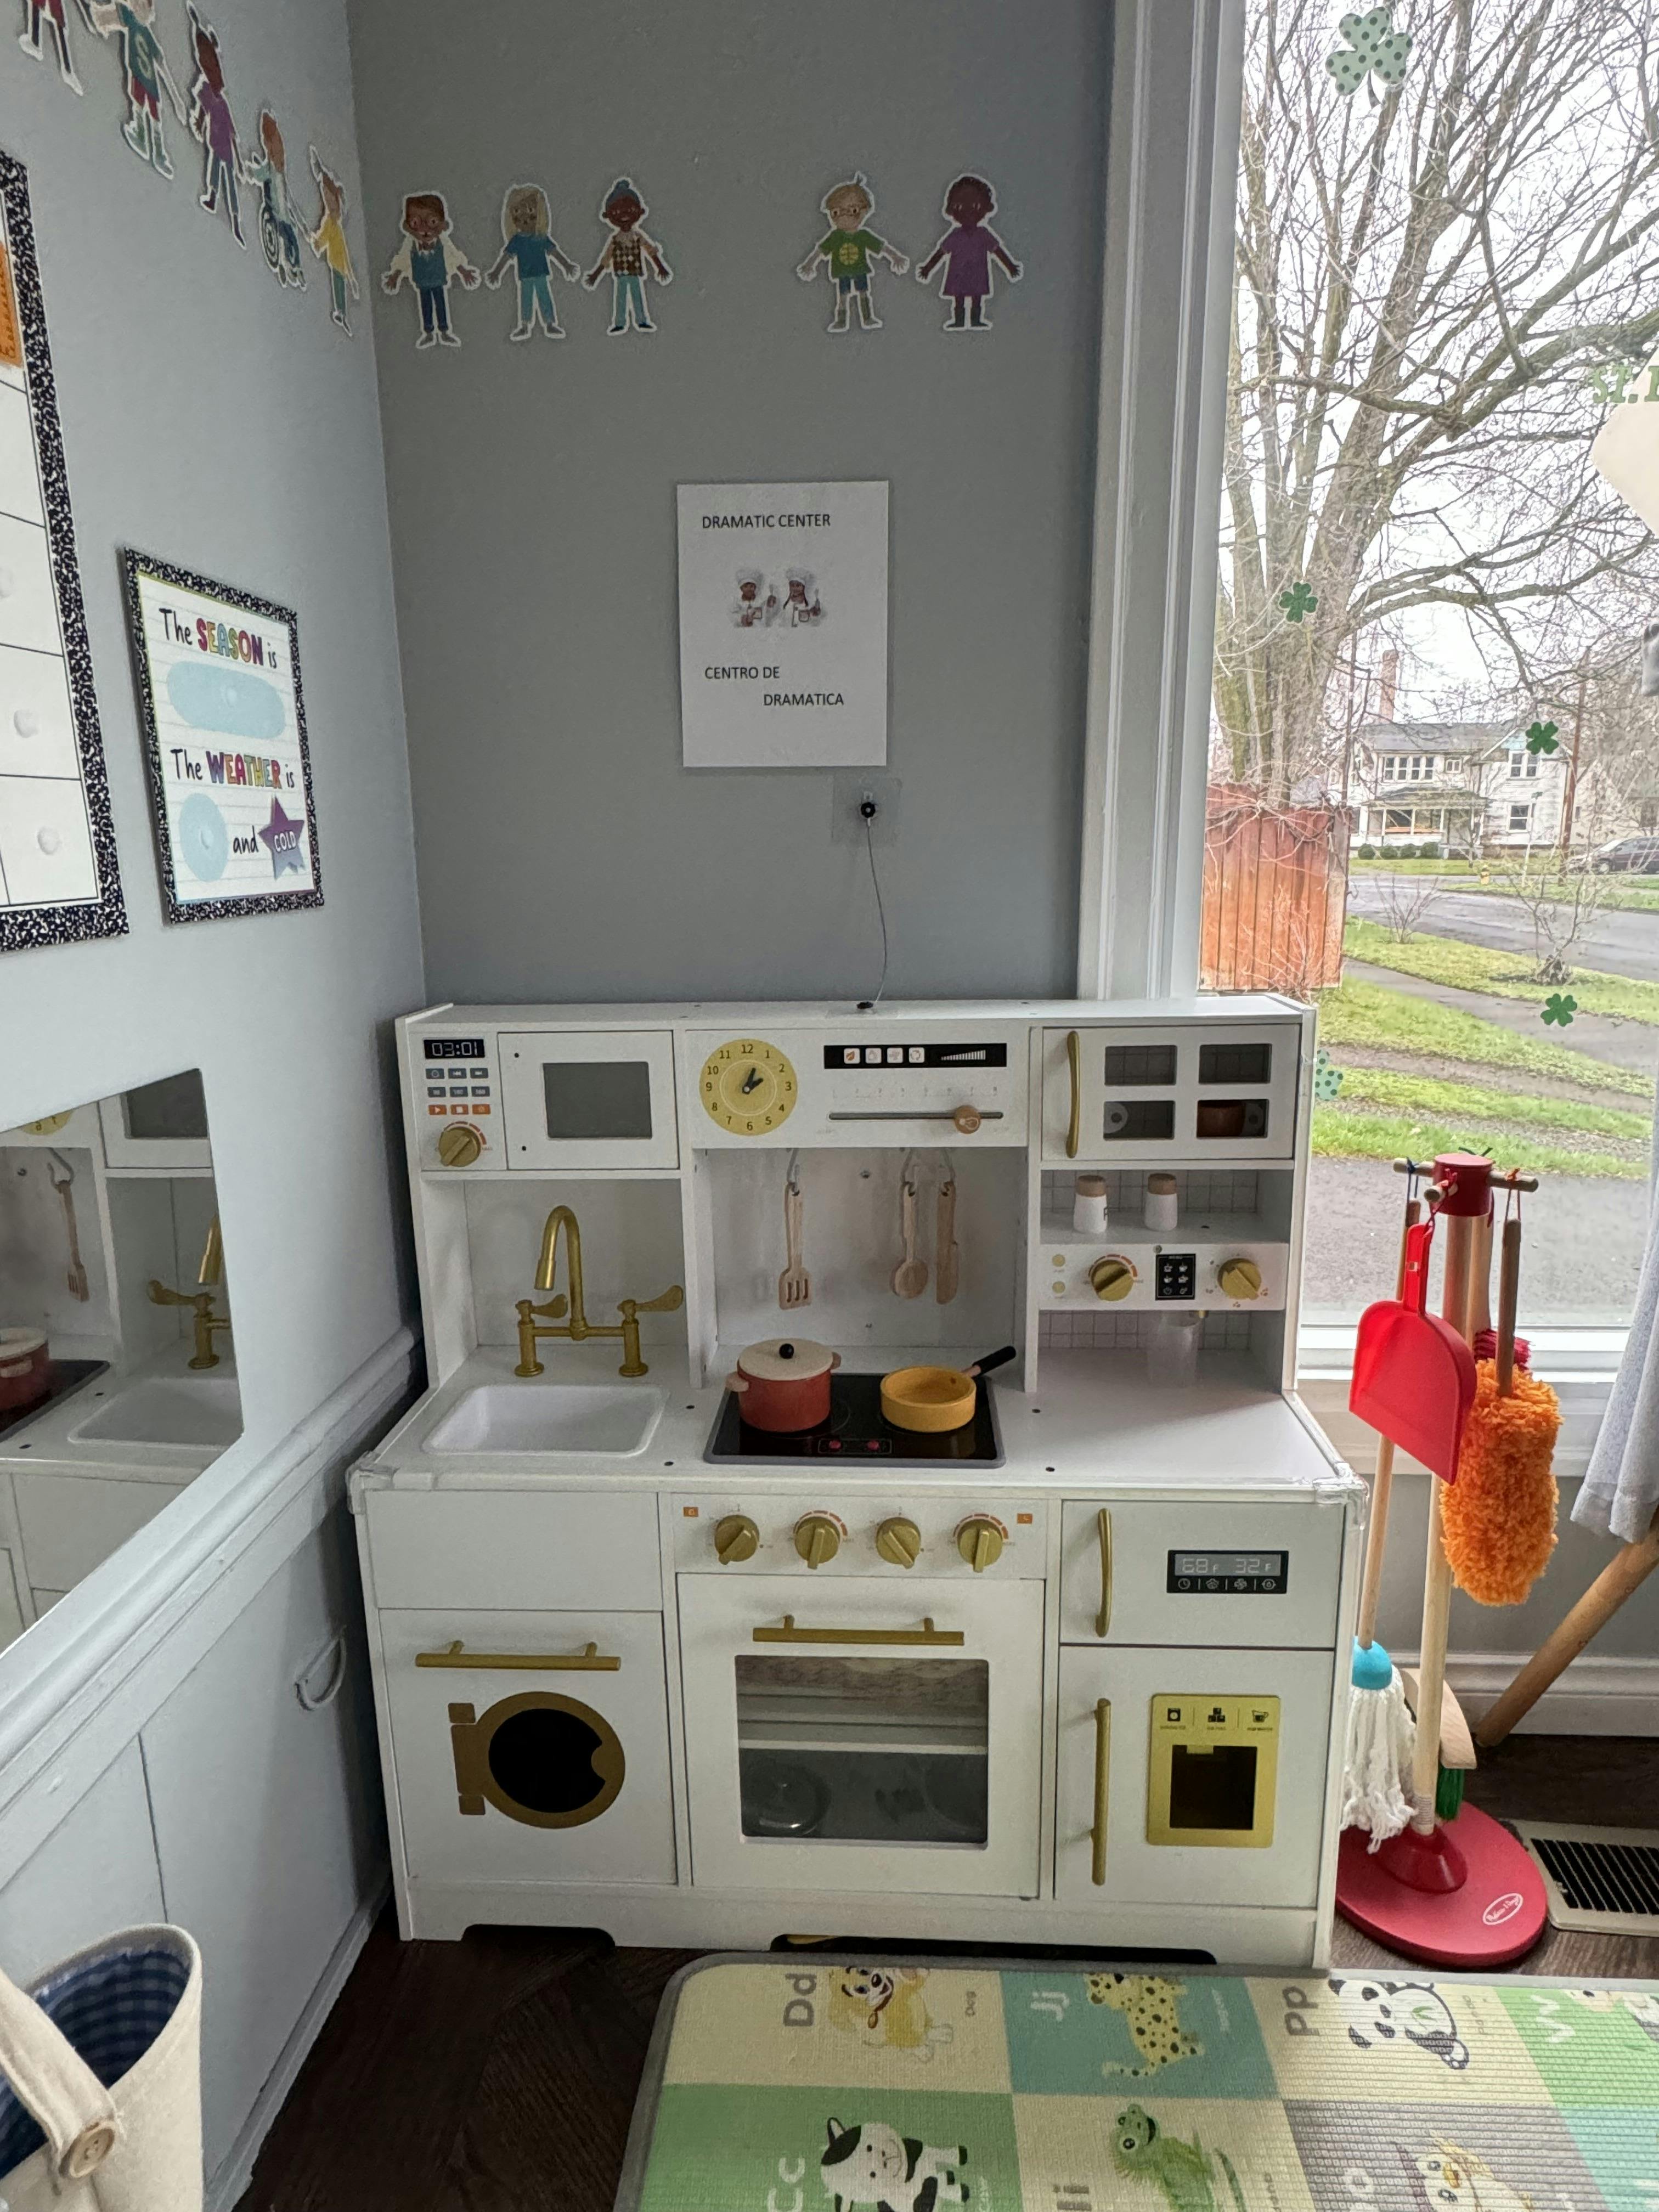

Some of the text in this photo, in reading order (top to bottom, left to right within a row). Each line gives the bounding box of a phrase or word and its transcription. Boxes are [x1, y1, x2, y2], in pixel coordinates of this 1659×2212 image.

[702, 513, 831, 529] DRAMATIC CENTER
[159, 608, 277, 669] The SEASON is
[704, 666, 781, 679] CENTRO DE
[763, 692, 845, 707] DRAMATICA
[170, 748, 295, 789] The WEATHER is
[233, 825, 297, 855] and COLD
[431, 1041, 478, 1057] 03:01
[719, 1050, 730, 1059] 11
[742, 1043, 753, 1053] 12
[765, 1050, 770, 1058] 1
[707, 1065, 718, 1075] 10
[778, 1064, 785, 1073] 2
[706, 1082, 712, 1091] 9
[785, 1081, 792, 1091] 3
[712, 1102, 718, 1111] 8
[726, 1116, 732, 1124] 7
[746, 1121, 753, 1131] 6
[765, 1116, 771, 1125] 5
[1235, 1558, 1261, 1573] 32
[1265, 1563, 1272, 1572] F
[782, 1973, 818, 2027] Dd
[964, 1990, 977, 2018] Dog
[1030, 1991, 1071, 2022] Jj
[1282, 1985, 1320, 2037] Pp
